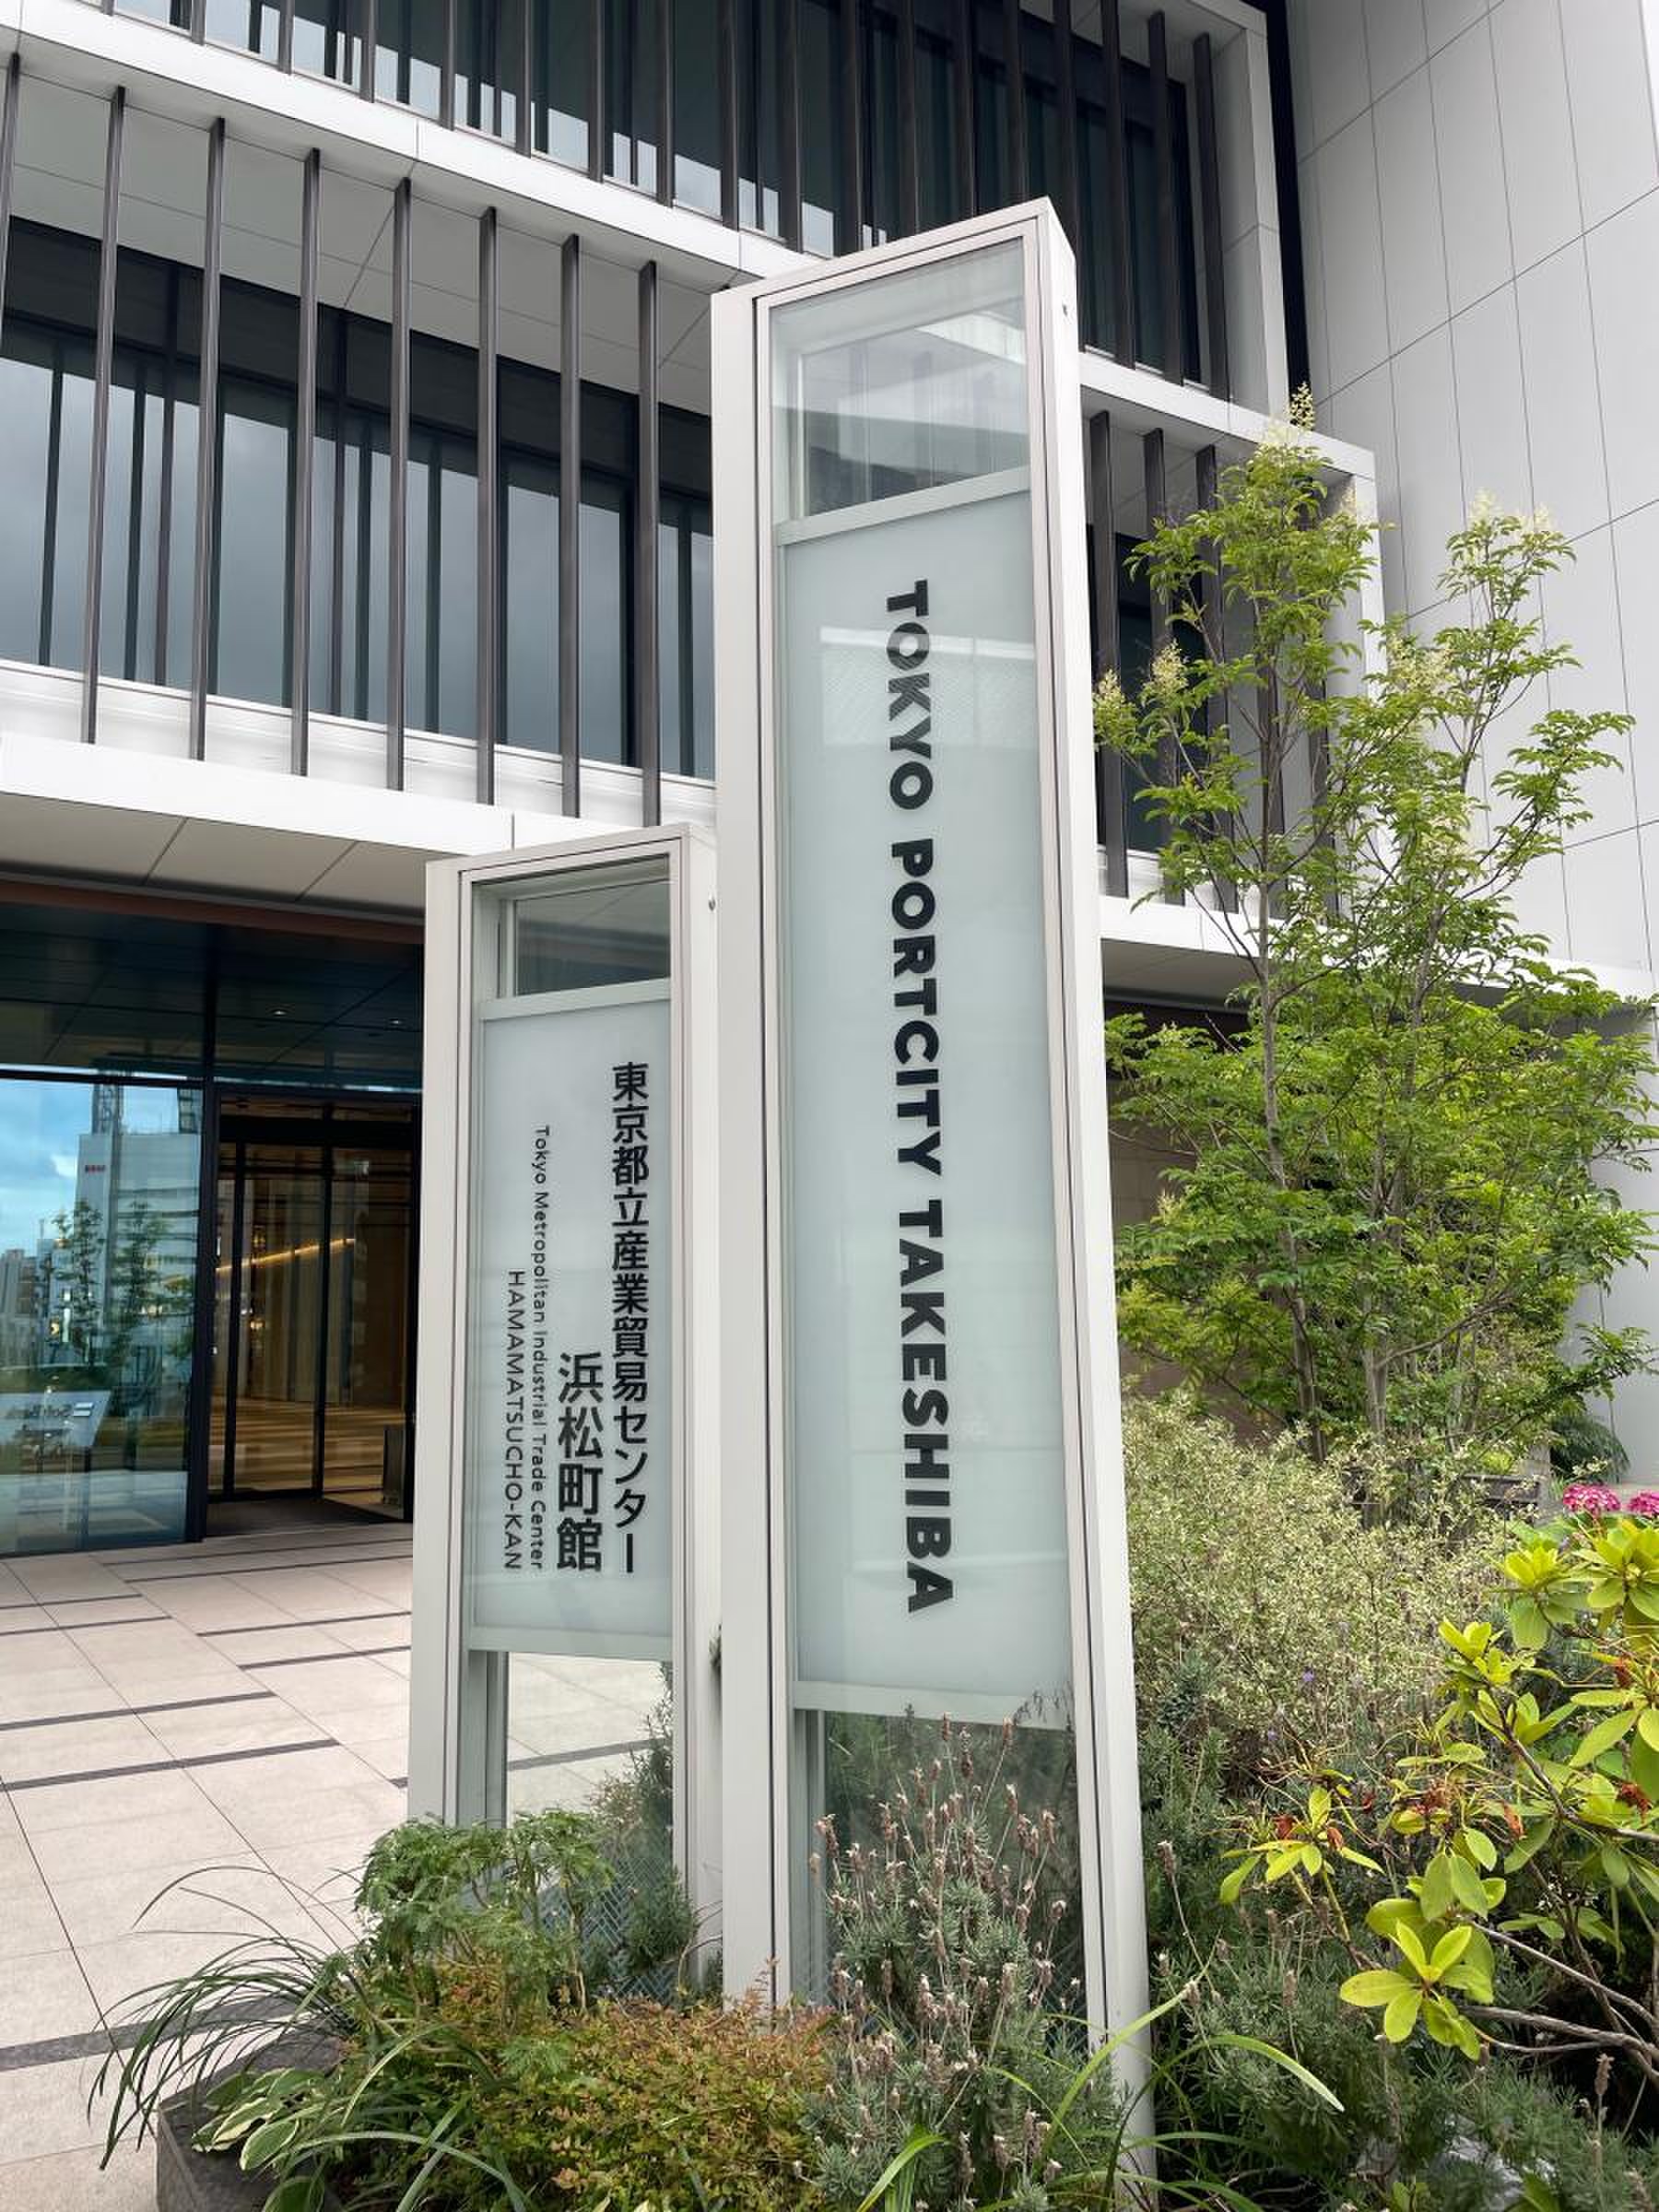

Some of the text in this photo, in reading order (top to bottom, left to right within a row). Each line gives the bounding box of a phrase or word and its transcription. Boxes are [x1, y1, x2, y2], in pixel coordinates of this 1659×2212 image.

[612, 1061, 649, 1574] 東京都立産業貿易センター
[886, 579, 954, 1613] TOKYO PORTCITY TAKESHIBA
[504, 1271, 525, 1569] HAMAMATSUCHO-KAN
[530, 1125, 550, 1569] Tokyo Metropolitan Industrial Trade Center
[557, 1351, 604, 1572] 浜松町館
